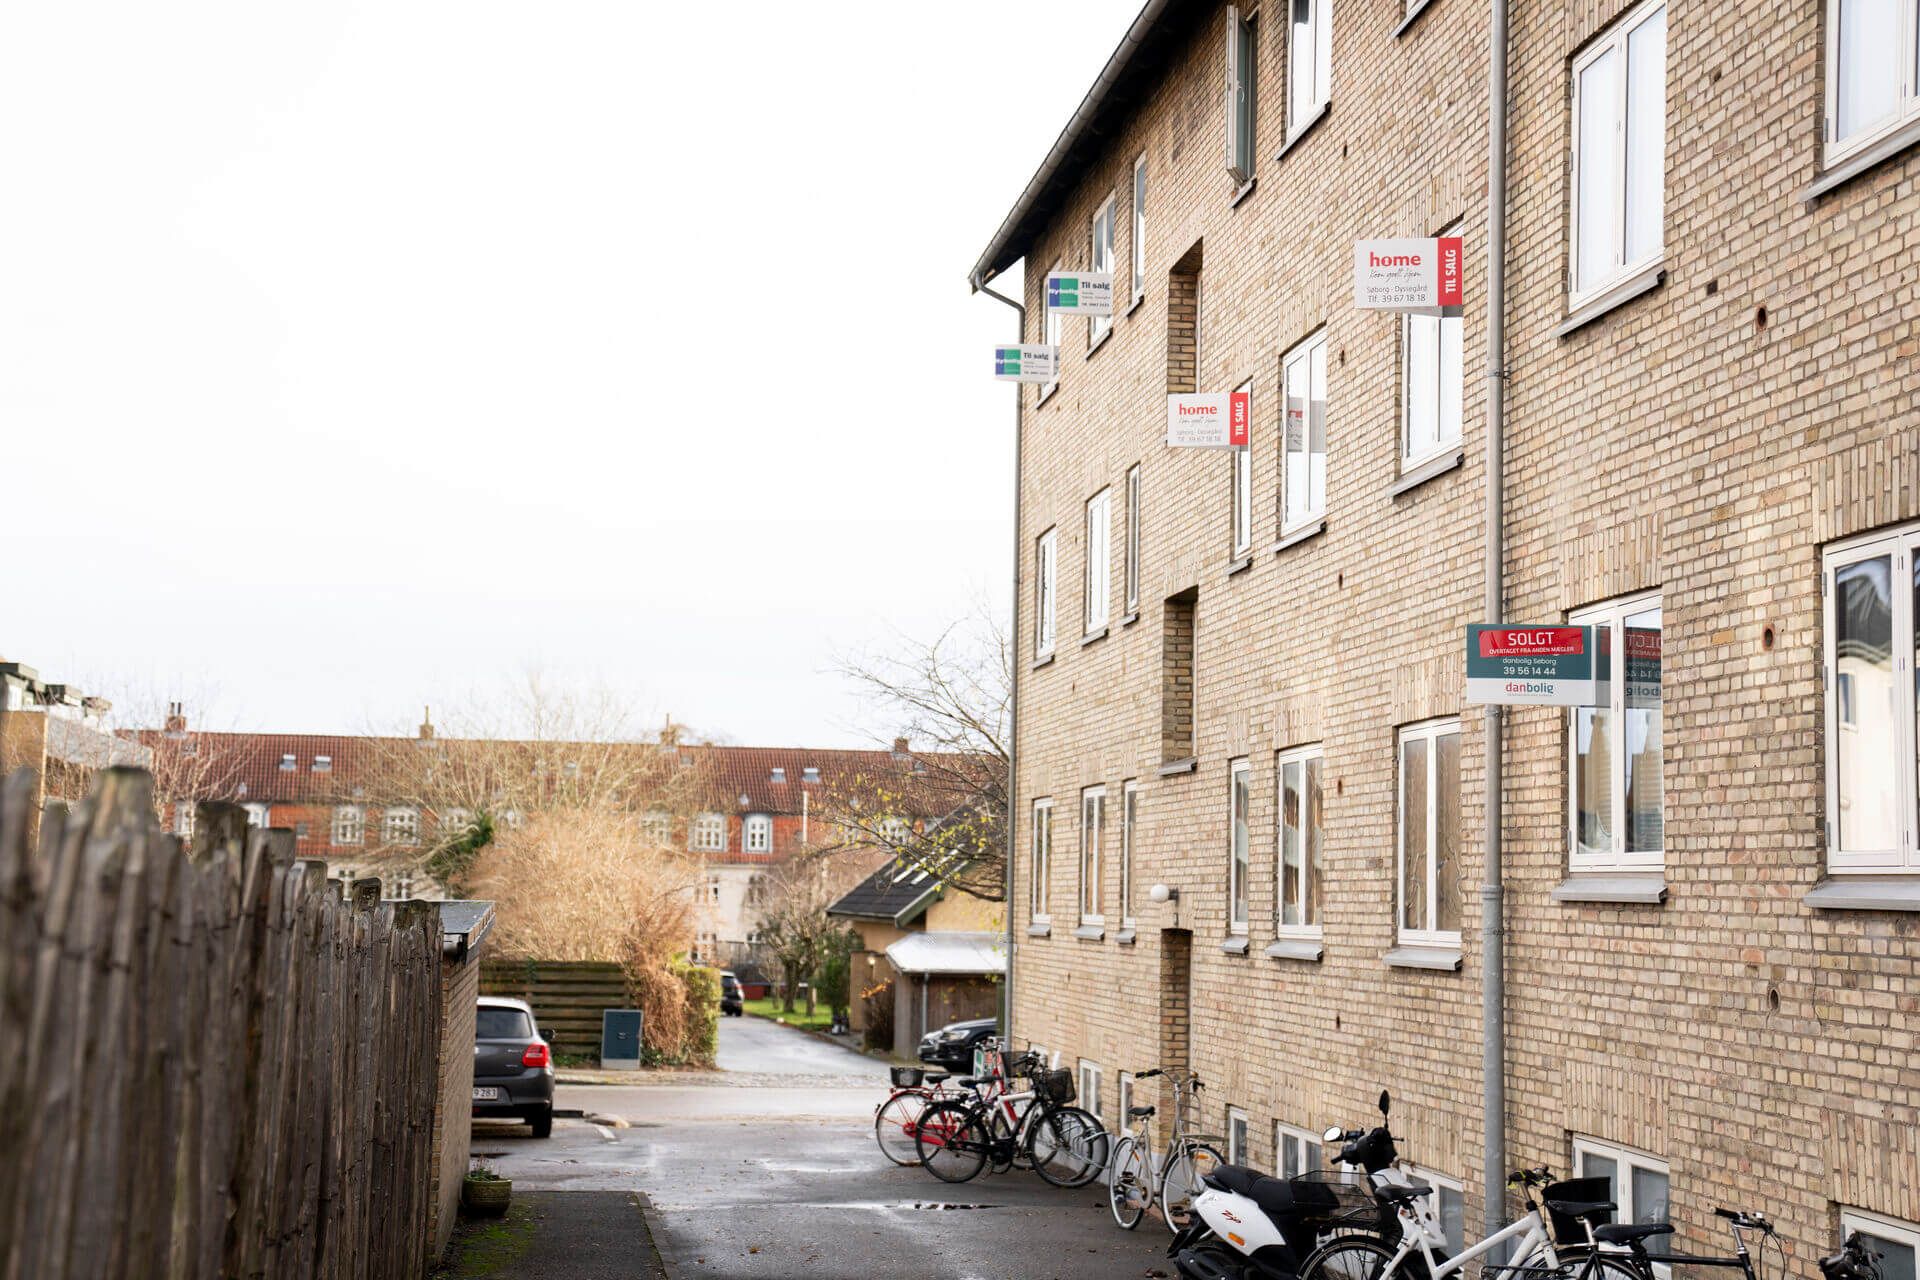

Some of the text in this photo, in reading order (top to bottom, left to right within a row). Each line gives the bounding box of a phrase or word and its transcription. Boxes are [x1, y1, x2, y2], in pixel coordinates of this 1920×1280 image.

[1369, 251, 1421, 267] home
[1445, 249, 1456, 294] TIL SALG
[1081, 281, 1110, 290] Til salg
[1382, 295, 1392, 303] 39
[1394, 294, 1404, 302] 67
[1407, 294, 1415, 302] 18
[1417, 294, 1426, 302] 18
[1179, 403, 1217, 415] home
[1235, 401, 1244, 436] TIL SALG
[1508, 632, 1554, 646] SOLGT
[1489, 647, 1519, 655] OVERTAGET
[1502, 657, 1532, 665] danbolig
[1503, 666, 1556, 675] 39 56 14 44
[1505, 682, 1554, 694] danbolig
